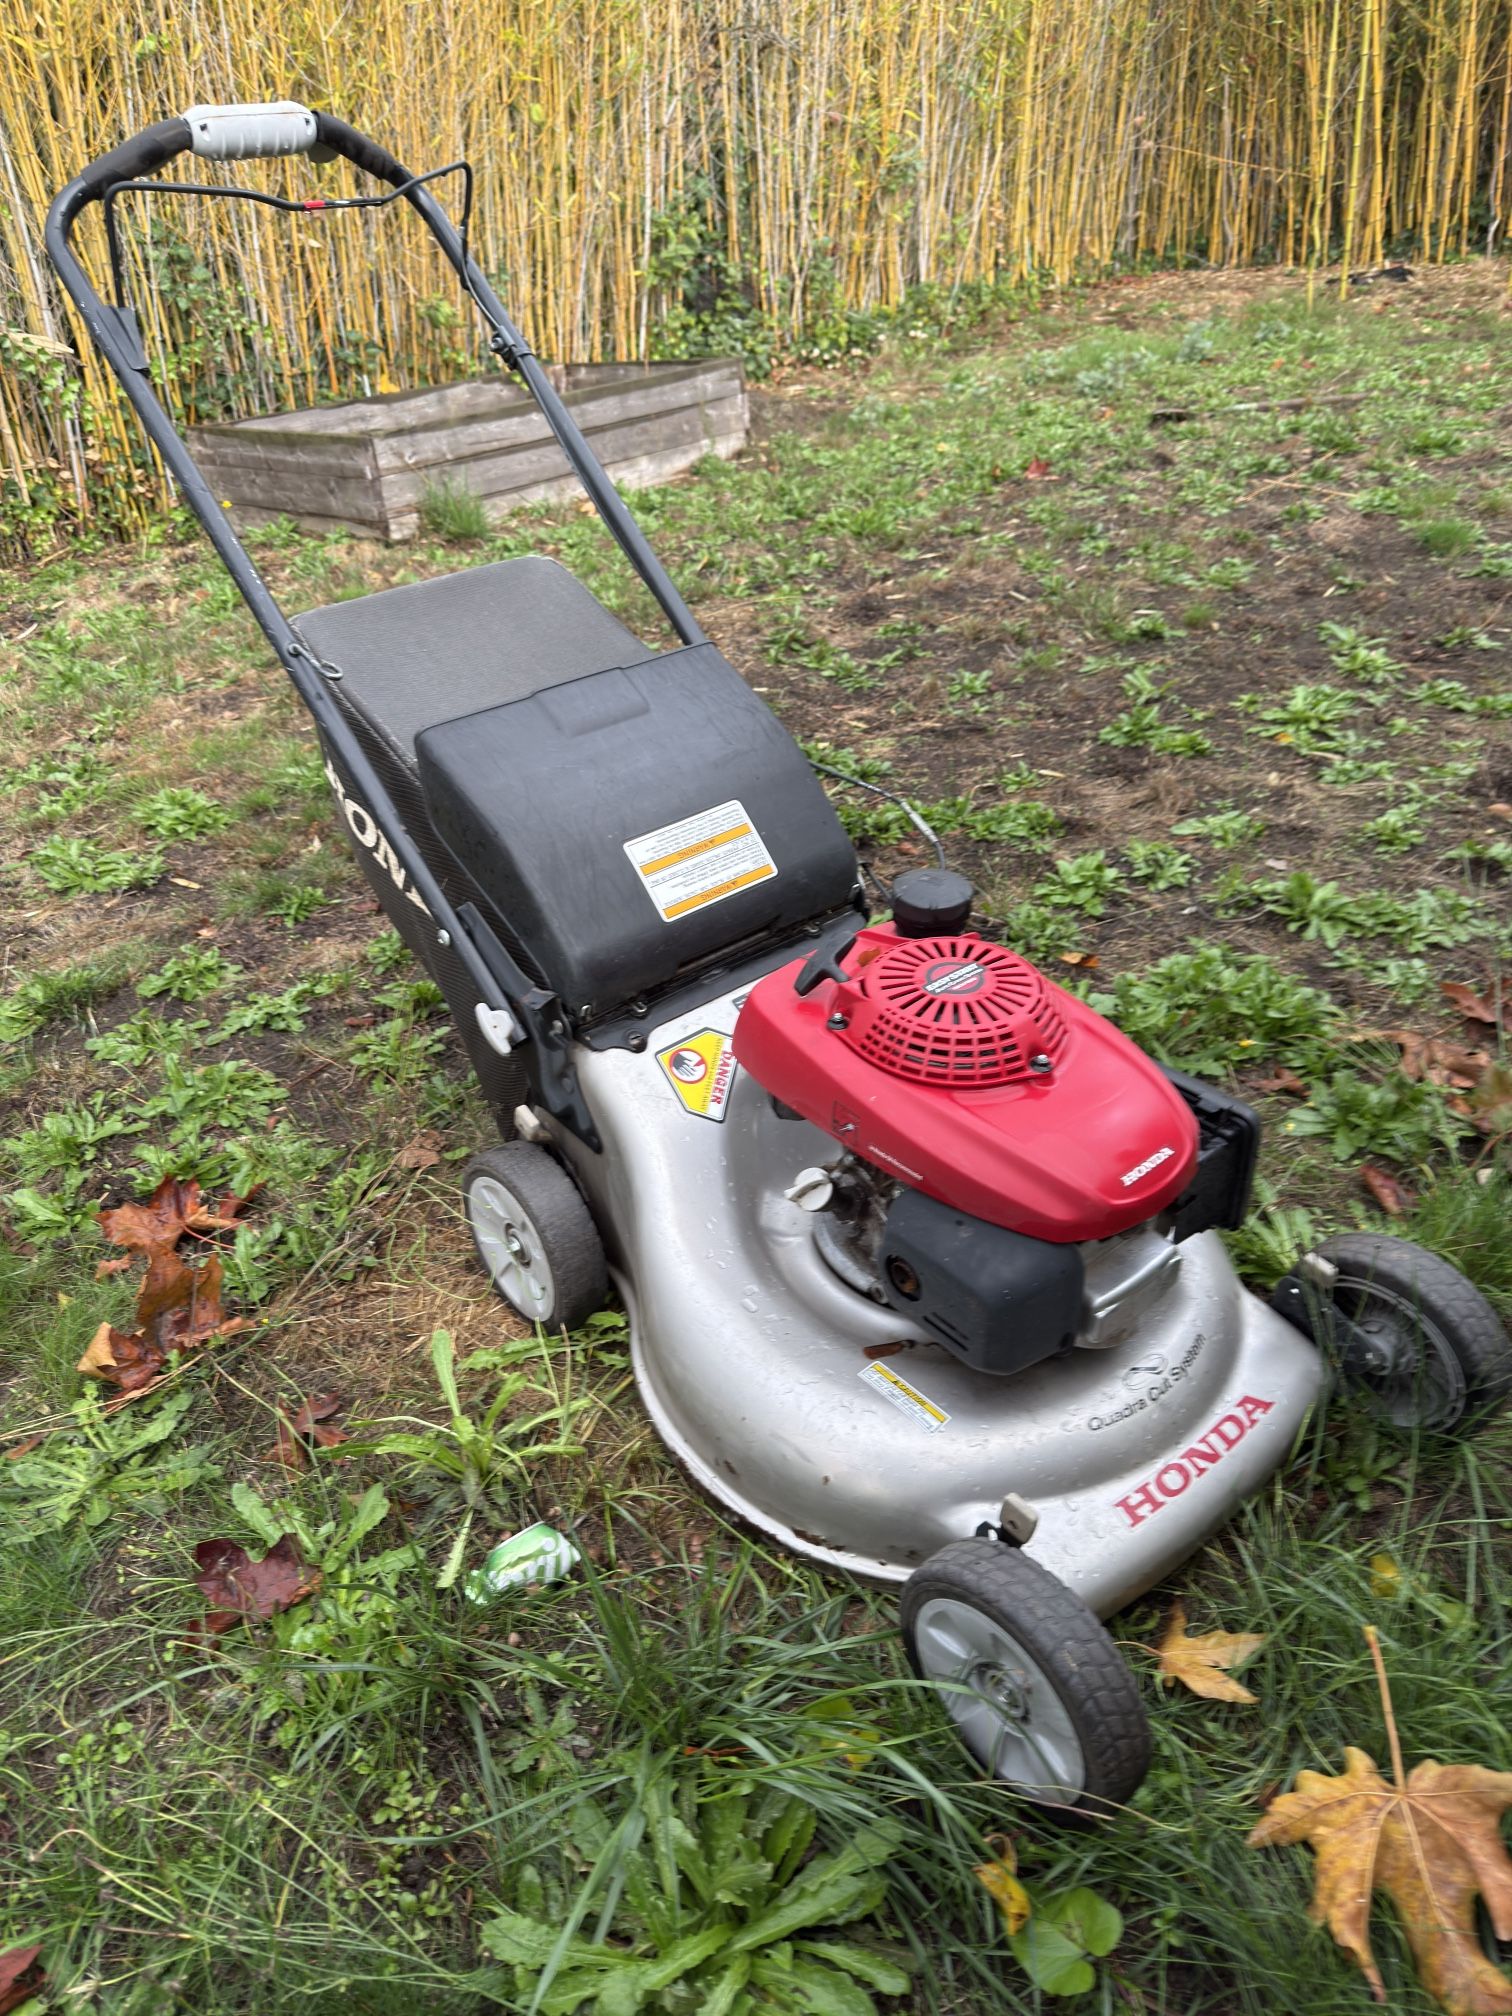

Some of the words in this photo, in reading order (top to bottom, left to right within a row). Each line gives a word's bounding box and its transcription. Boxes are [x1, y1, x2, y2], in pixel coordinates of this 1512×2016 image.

[711, 1051, 734, 1105] DANGER
[1120, 1147, 1175, 1186] HONDA
[1087, 1398, 1149, 1432] Quadra
[1147, 1377, 1173, 1402] Cut
[1169, 1333, 1207, 1382] System
[1114, 1395, 1277, 1528] HONDA
